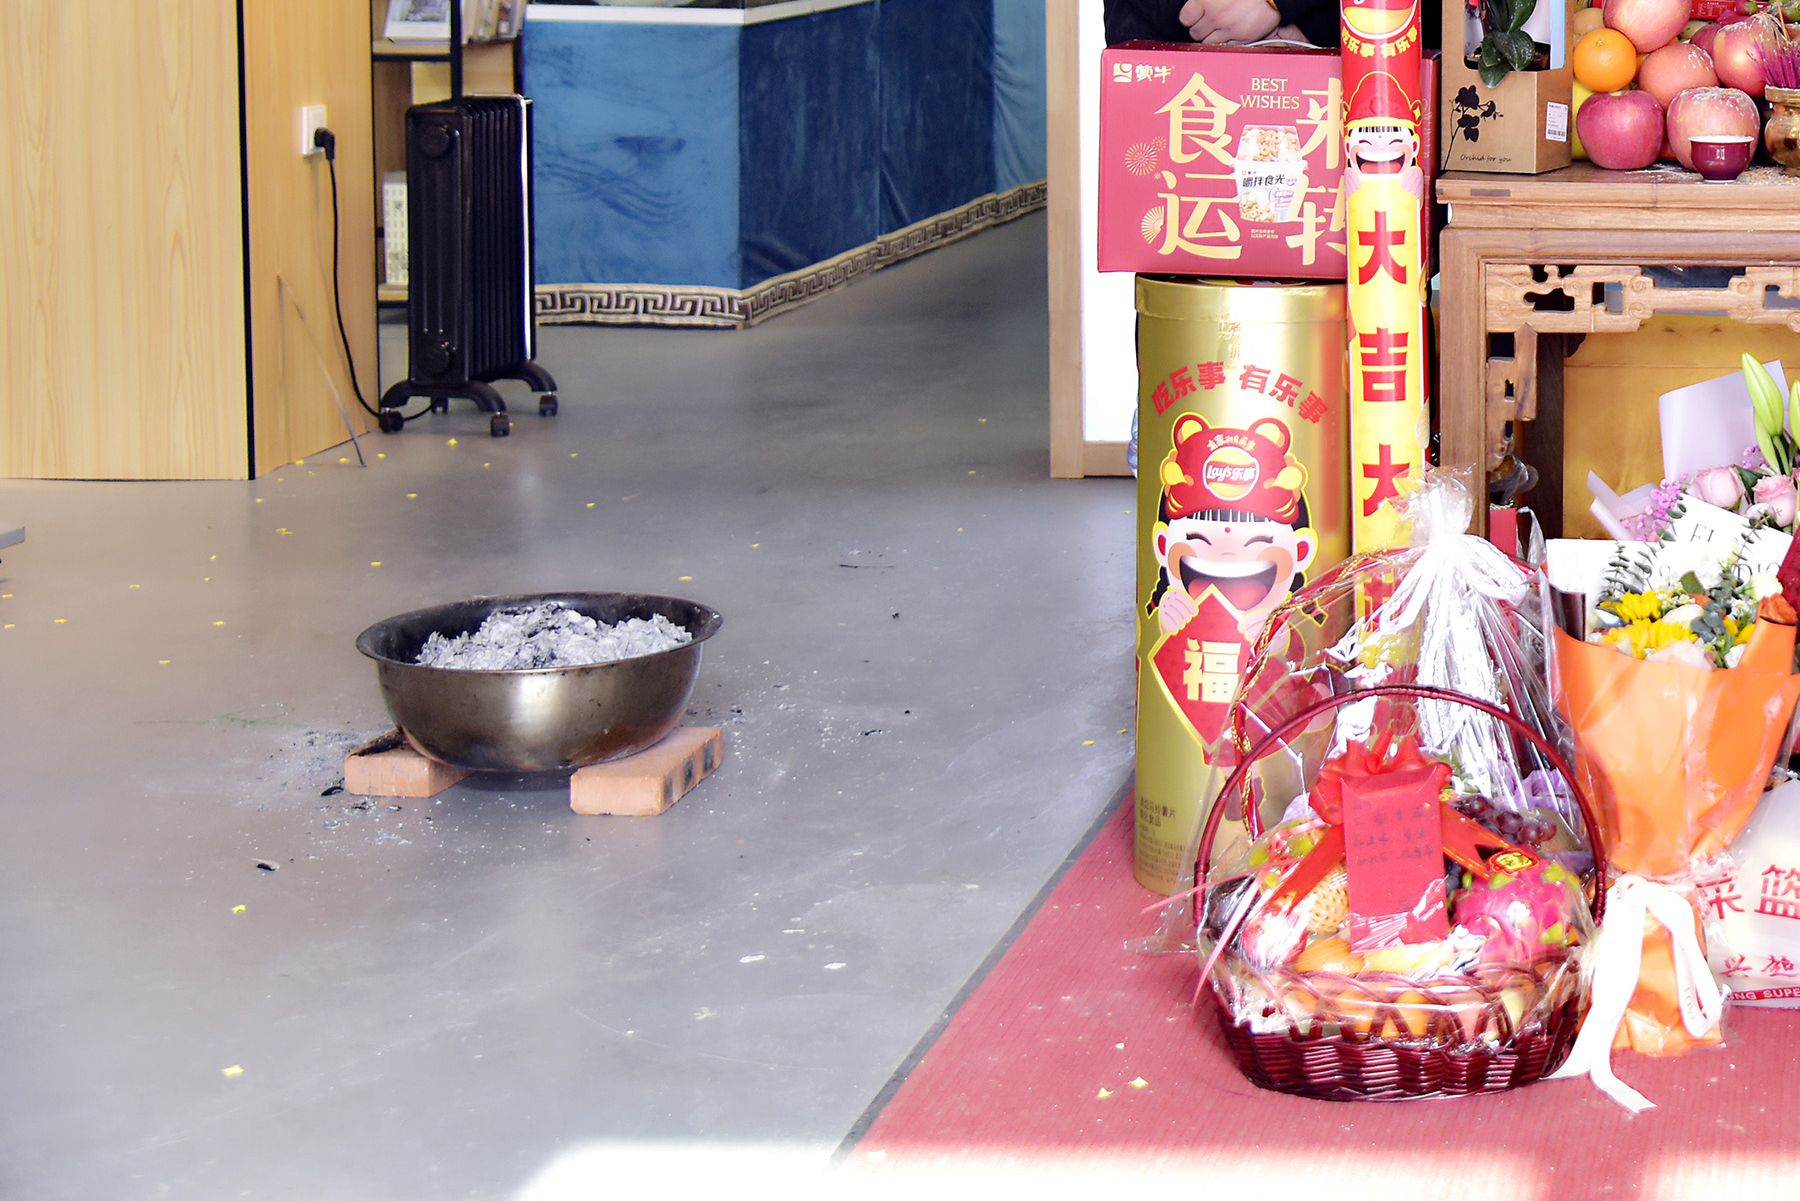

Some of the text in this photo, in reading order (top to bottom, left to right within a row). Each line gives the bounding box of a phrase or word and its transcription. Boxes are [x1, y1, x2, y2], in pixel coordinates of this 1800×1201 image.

[1135, 64, 1173, 84] 蒙牛
[1251, 77, 1288, 92] BEST
[1239, 94, 1300, 110] WISHES
[1151, 359, 1330, 426] 吃乐事 有乐事
[1184, 637, 1242, 704] 福
